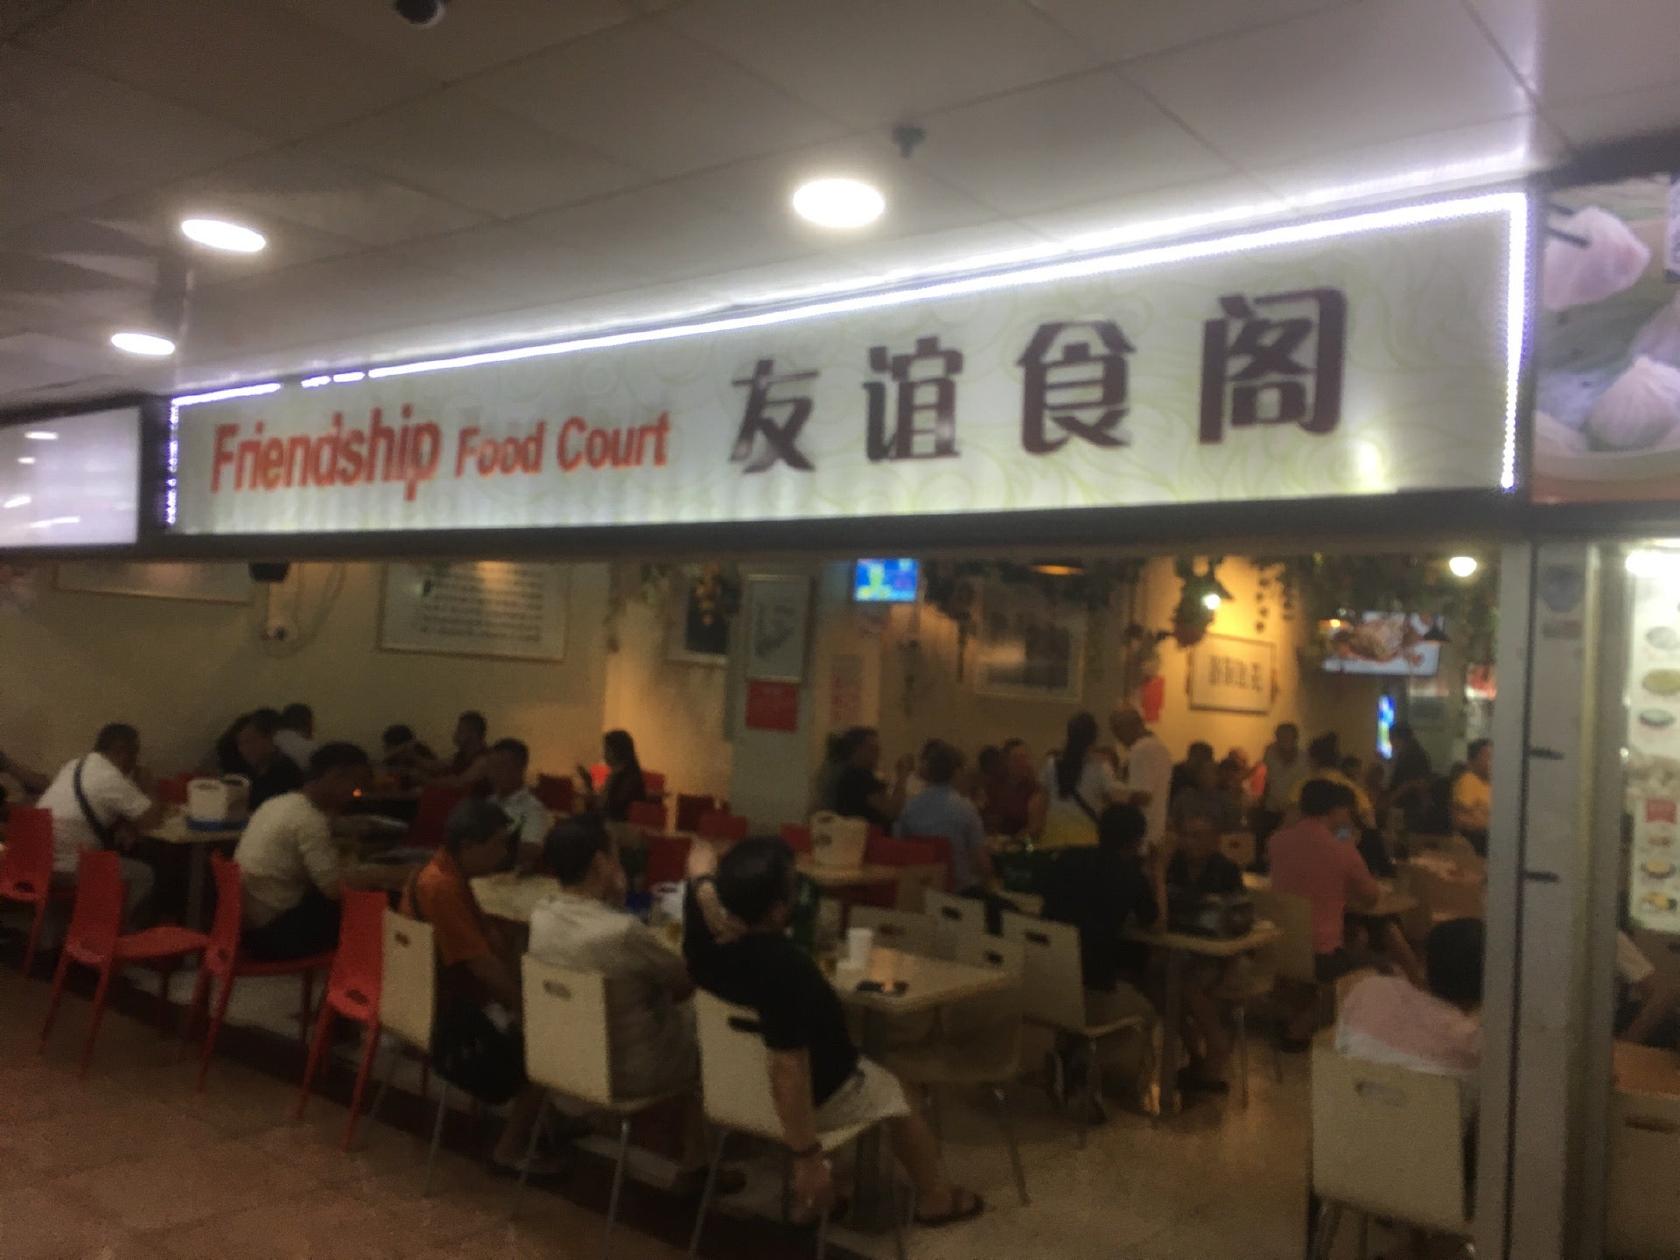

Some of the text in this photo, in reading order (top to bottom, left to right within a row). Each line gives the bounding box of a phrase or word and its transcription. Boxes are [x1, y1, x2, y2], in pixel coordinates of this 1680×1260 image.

[730, 287, 1348, 474] 友谊食阁
[210, 404, 671, 501] Friendship Food Court
